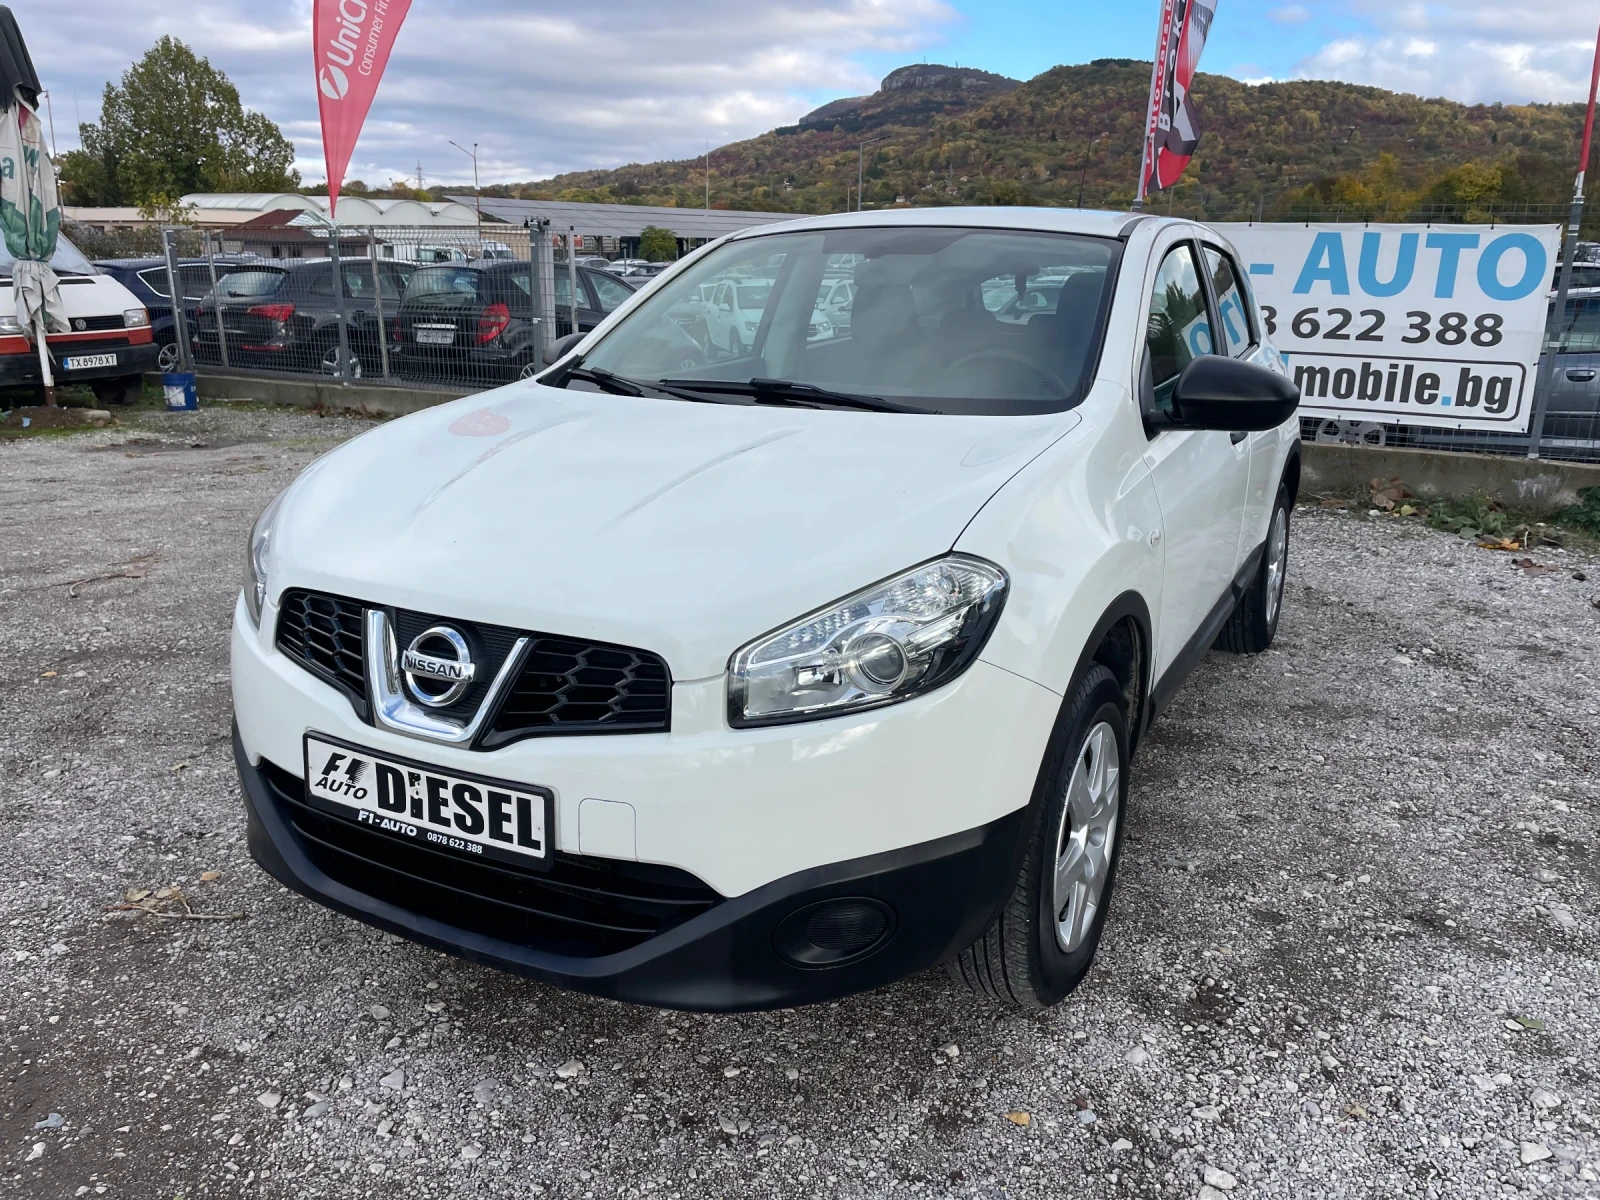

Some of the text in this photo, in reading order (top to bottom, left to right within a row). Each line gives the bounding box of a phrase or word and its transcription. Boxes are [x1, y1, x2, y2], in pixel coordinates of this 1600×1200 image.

[357, 15, 384, 76] Consumer
[1292, 231, 1547, 301] AUTO
[1291, 307, 1386, 342] 622
[1401, 310, 1504, 347] 388
[70, 354, 115, 368] TX 8978 XT
[1294, 362, 1513, 414] mobile.bg
[405, 654, 462, 678] NISSAN
[321, 752, 369, 785] F1
[315, 776, 368, 800] AUTO
[357, 809, 417, 836] F1-AUTO
[427, 831, 483, 854] 0878 622 388
